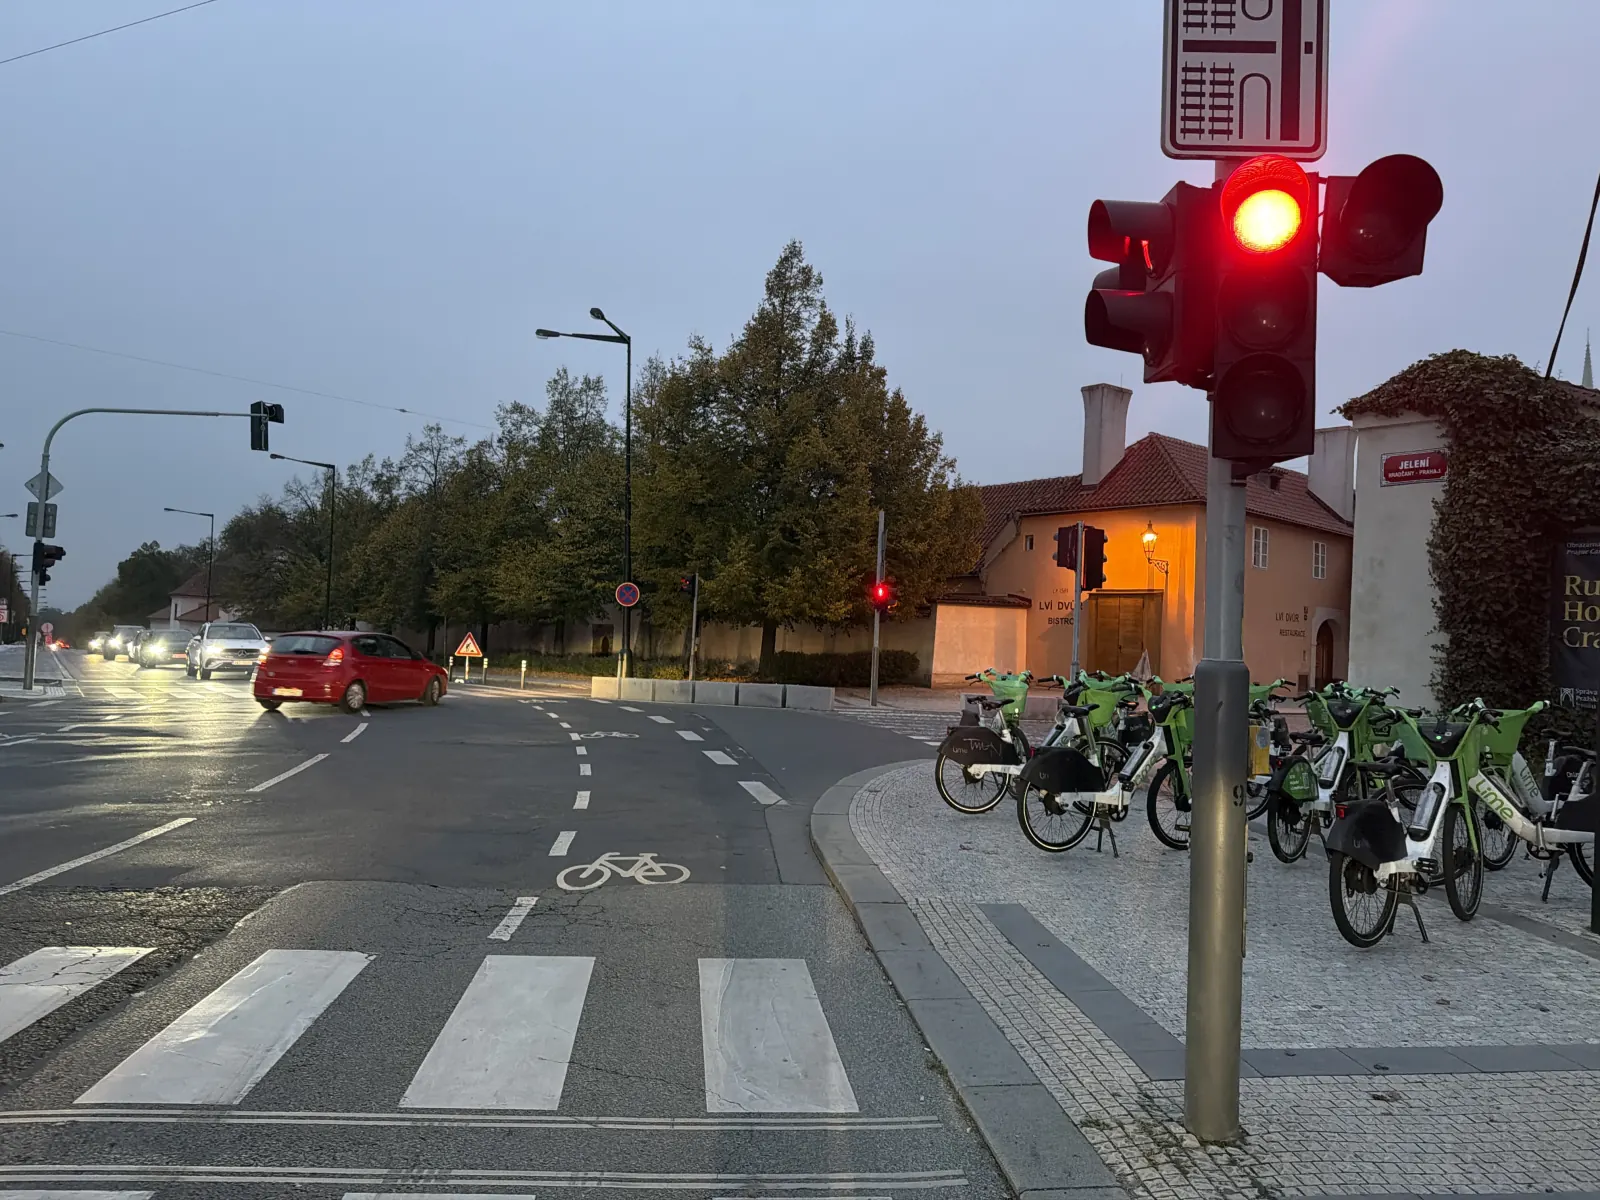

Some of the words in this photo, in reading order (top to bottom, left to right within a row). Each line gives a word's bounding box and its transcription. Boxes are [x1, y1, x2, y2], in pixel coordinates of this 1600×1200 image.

[1399, 456, 1431, 469] JELENÍ
[1388, 470, 1414, 478] HRADČANY
[1562, 600, 1600, 622] Ho
[1519, 765, 1539, 798] Lime
[1232, 784, 1245, 807] 9
[1475, 778, 1514, 820] Lime
